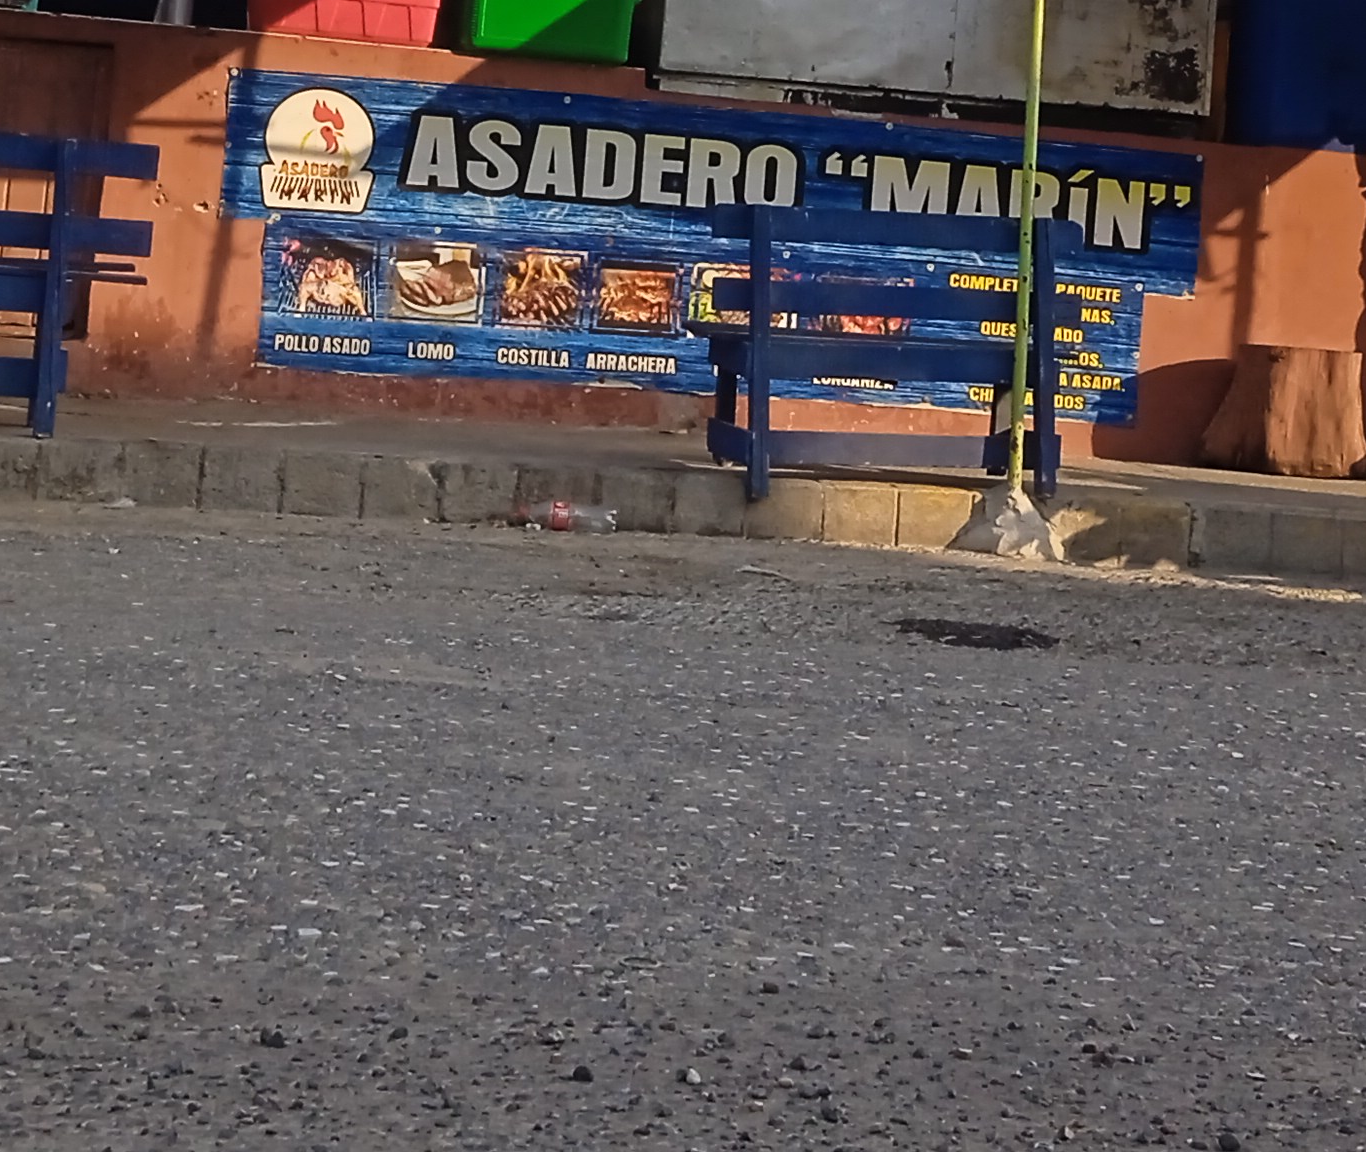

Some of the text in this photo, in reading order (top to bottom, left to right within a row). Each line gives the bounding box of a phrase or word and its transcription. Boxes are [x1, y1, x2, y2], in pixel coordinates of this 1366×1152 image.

[278, 159, 350, 179] ASADERO
[405, 114, 798, 208] ASADERO
[949, 273, 1019, 292] COMPLET
[274, 333, 371, 356] POLLO ASADO
[408, 341, 455, 361] LOMO
[497, 347, 570, 368] COSTILLA
[585, 352, 677, 375] ARRACHERA
